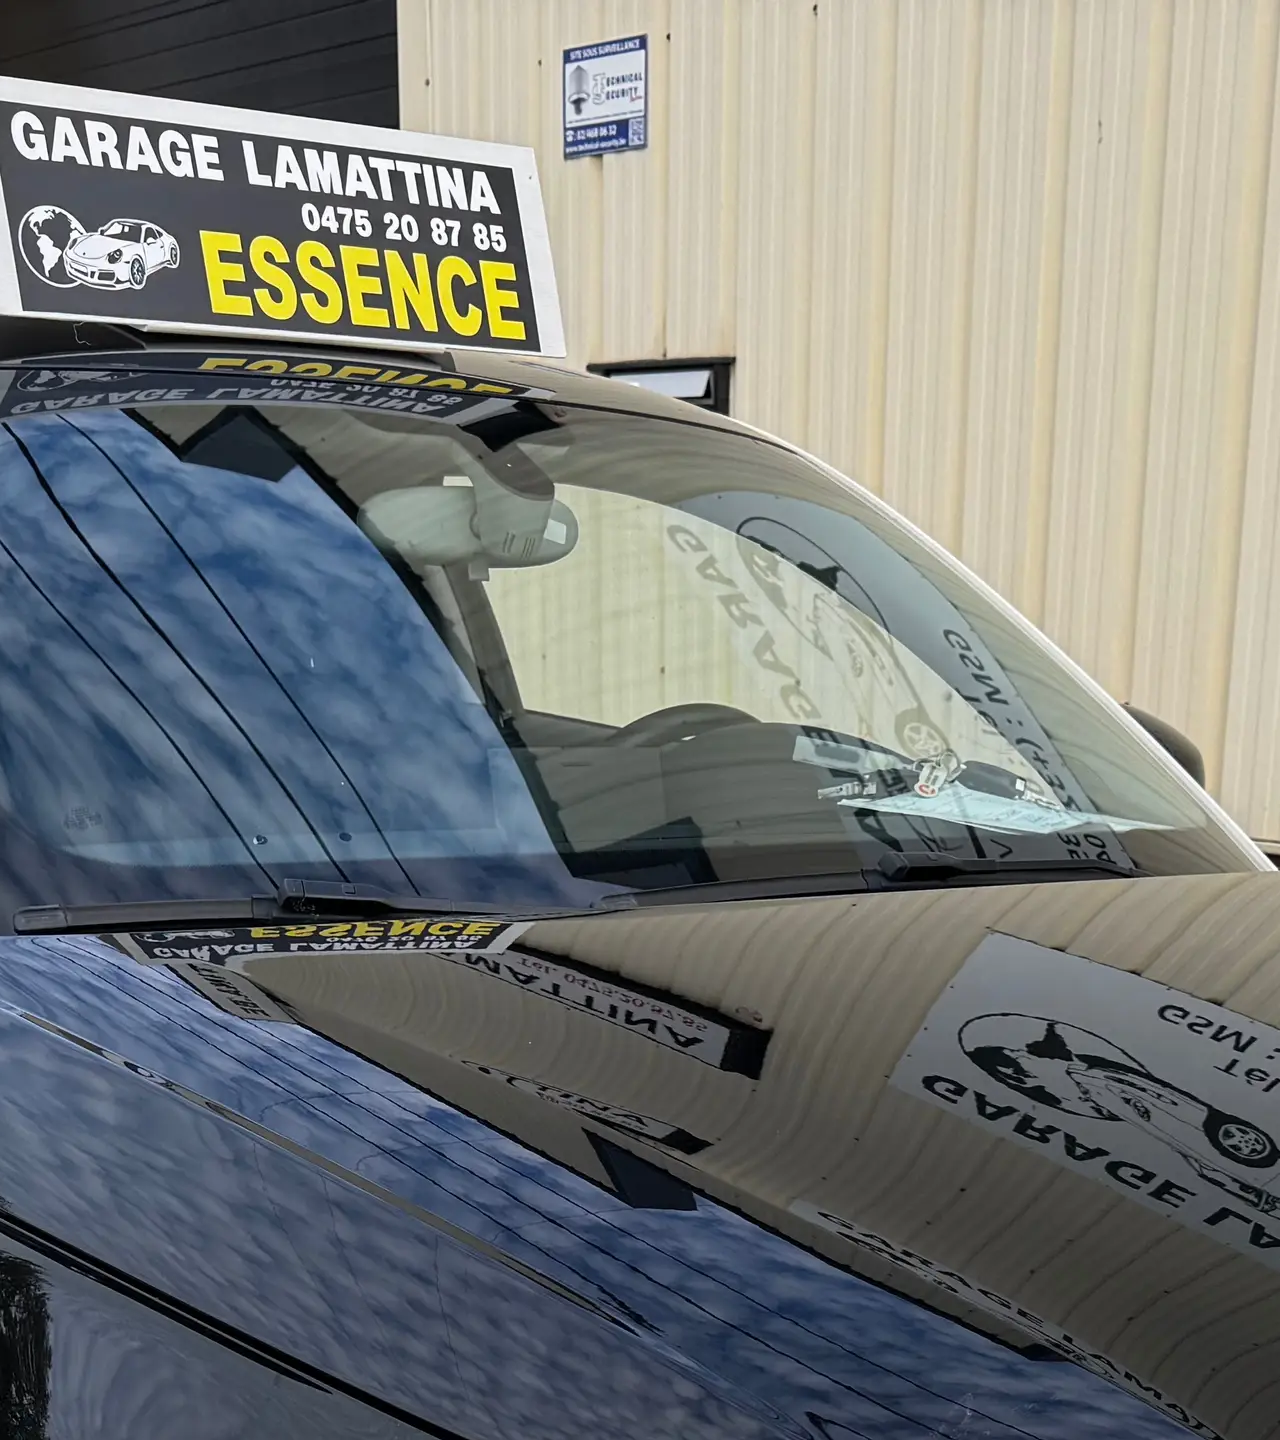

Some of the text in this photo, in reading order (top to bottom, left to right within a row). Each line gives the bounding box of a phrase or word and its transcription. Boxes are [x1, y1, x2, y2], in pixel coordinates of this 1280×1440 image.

[10, 110, 501, 215] GARAGE LAMATTINA
[302, 203, 508, 253] 0475 20 87 85
[199, 229, 526, 340] ESSENCE
